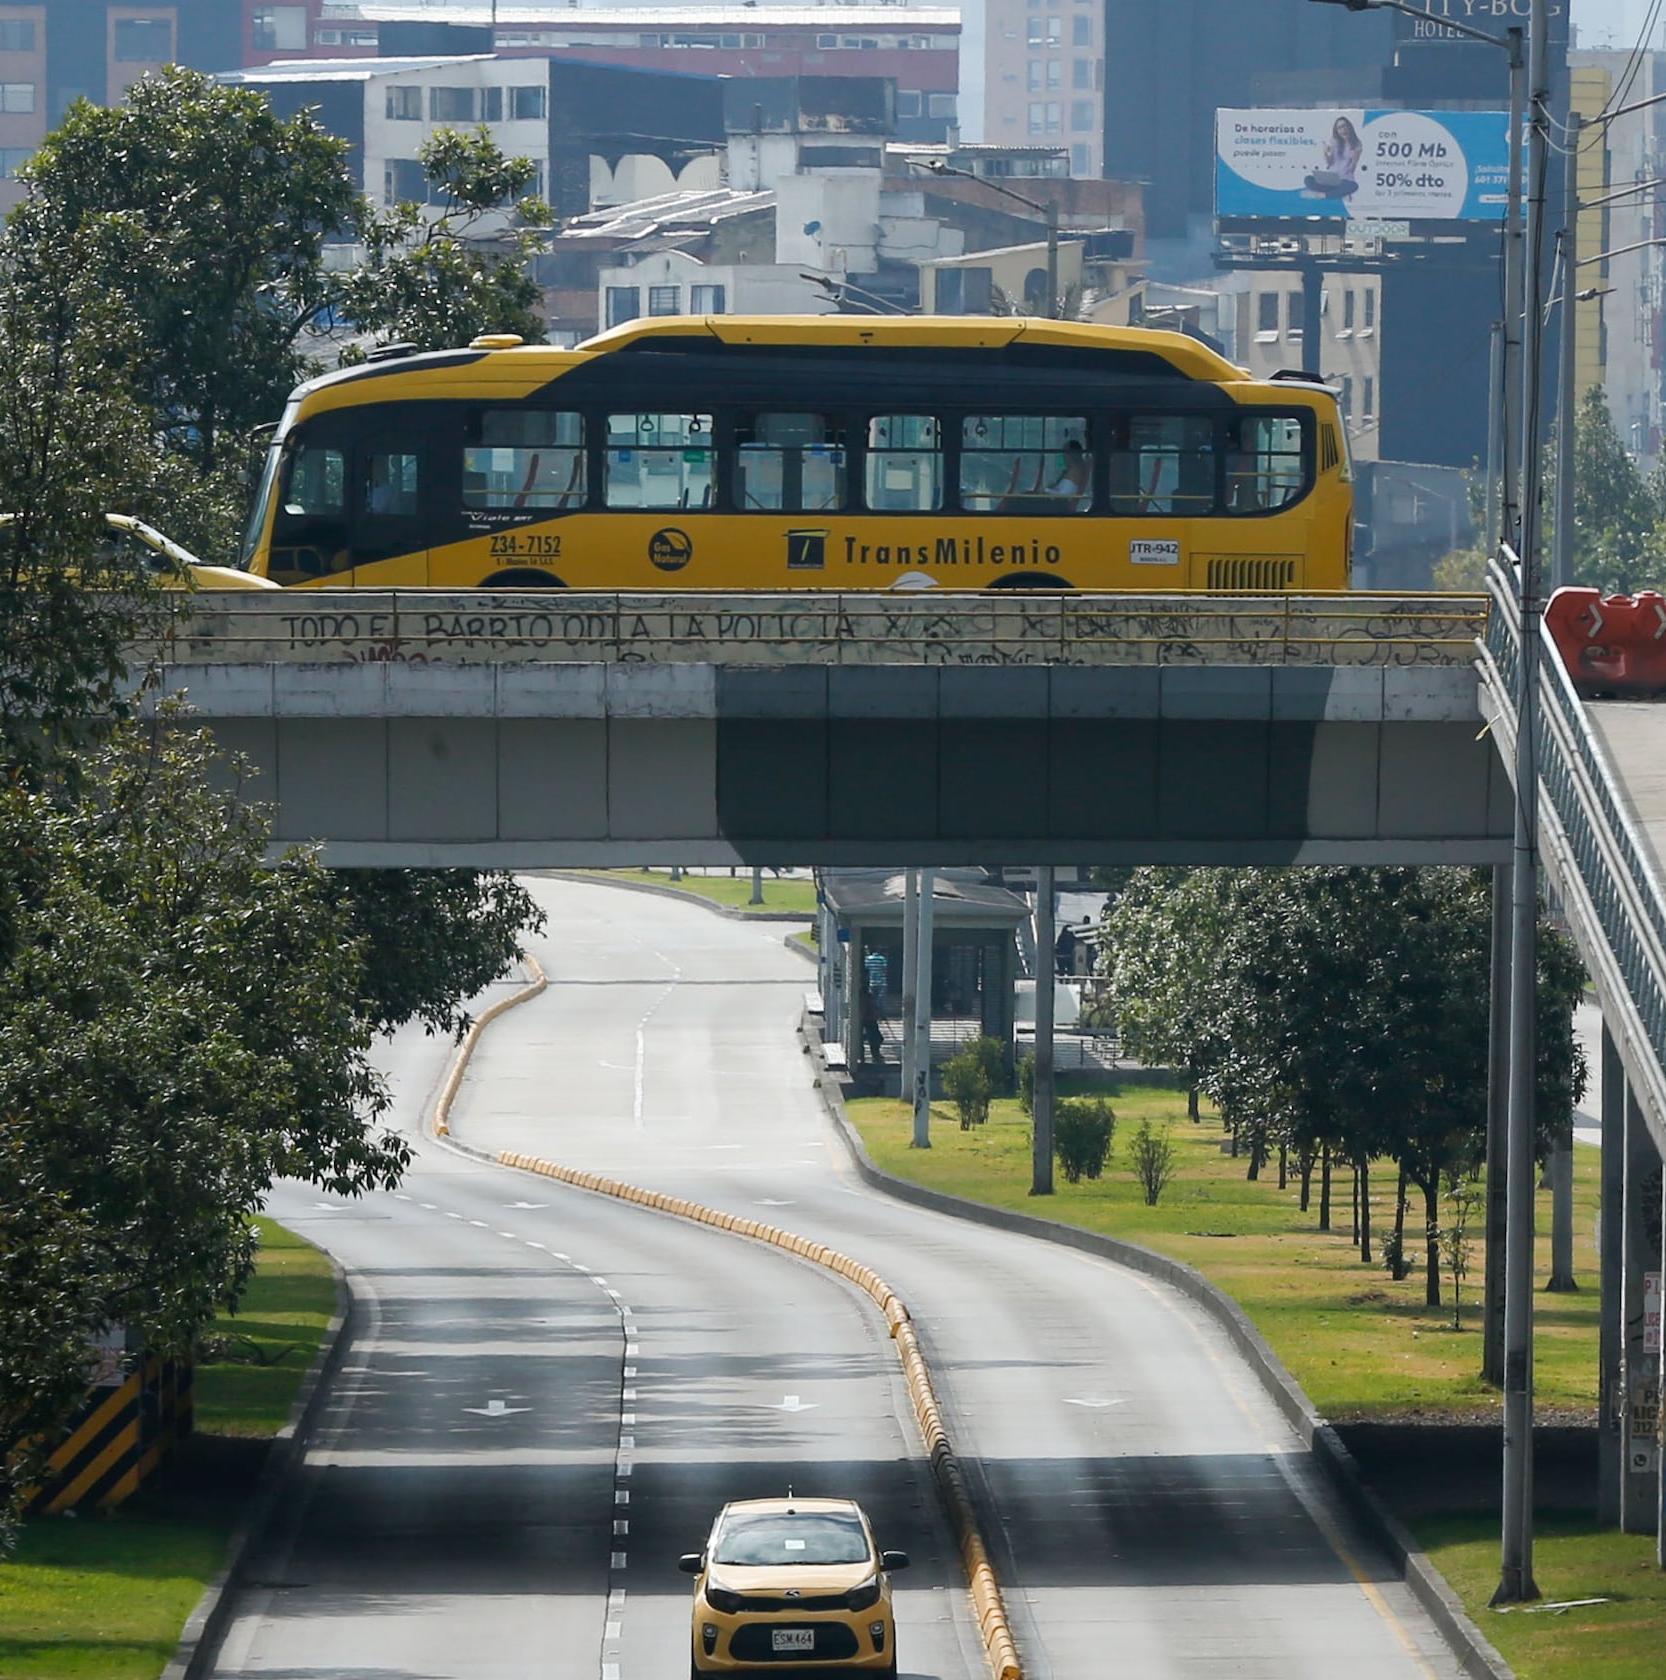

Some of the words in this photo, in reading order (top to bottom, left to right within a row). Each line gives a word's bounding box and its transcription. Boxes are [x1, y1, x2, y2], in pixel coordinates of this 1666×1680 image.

[1235, 124, 1248, 133] De
[1251, 124, 1295, 133] horarios
[1376, 142, 1412, 158] 500
[1418, 142, 1447, 158] Mb
[1376, 173, 1413, 188] 50%
[1347, 223, 1406, 233] OUTDOOR
[490, 535, 562, 553] Z34-7152
[653, 541, 671, 552] Gas
[844, 537, 1062, 565] TransMilenio
[653, 552, 688, 563] Natural
[280, 614, 360, 649] TODO
[423, 614, 553, 649] BARRIO
